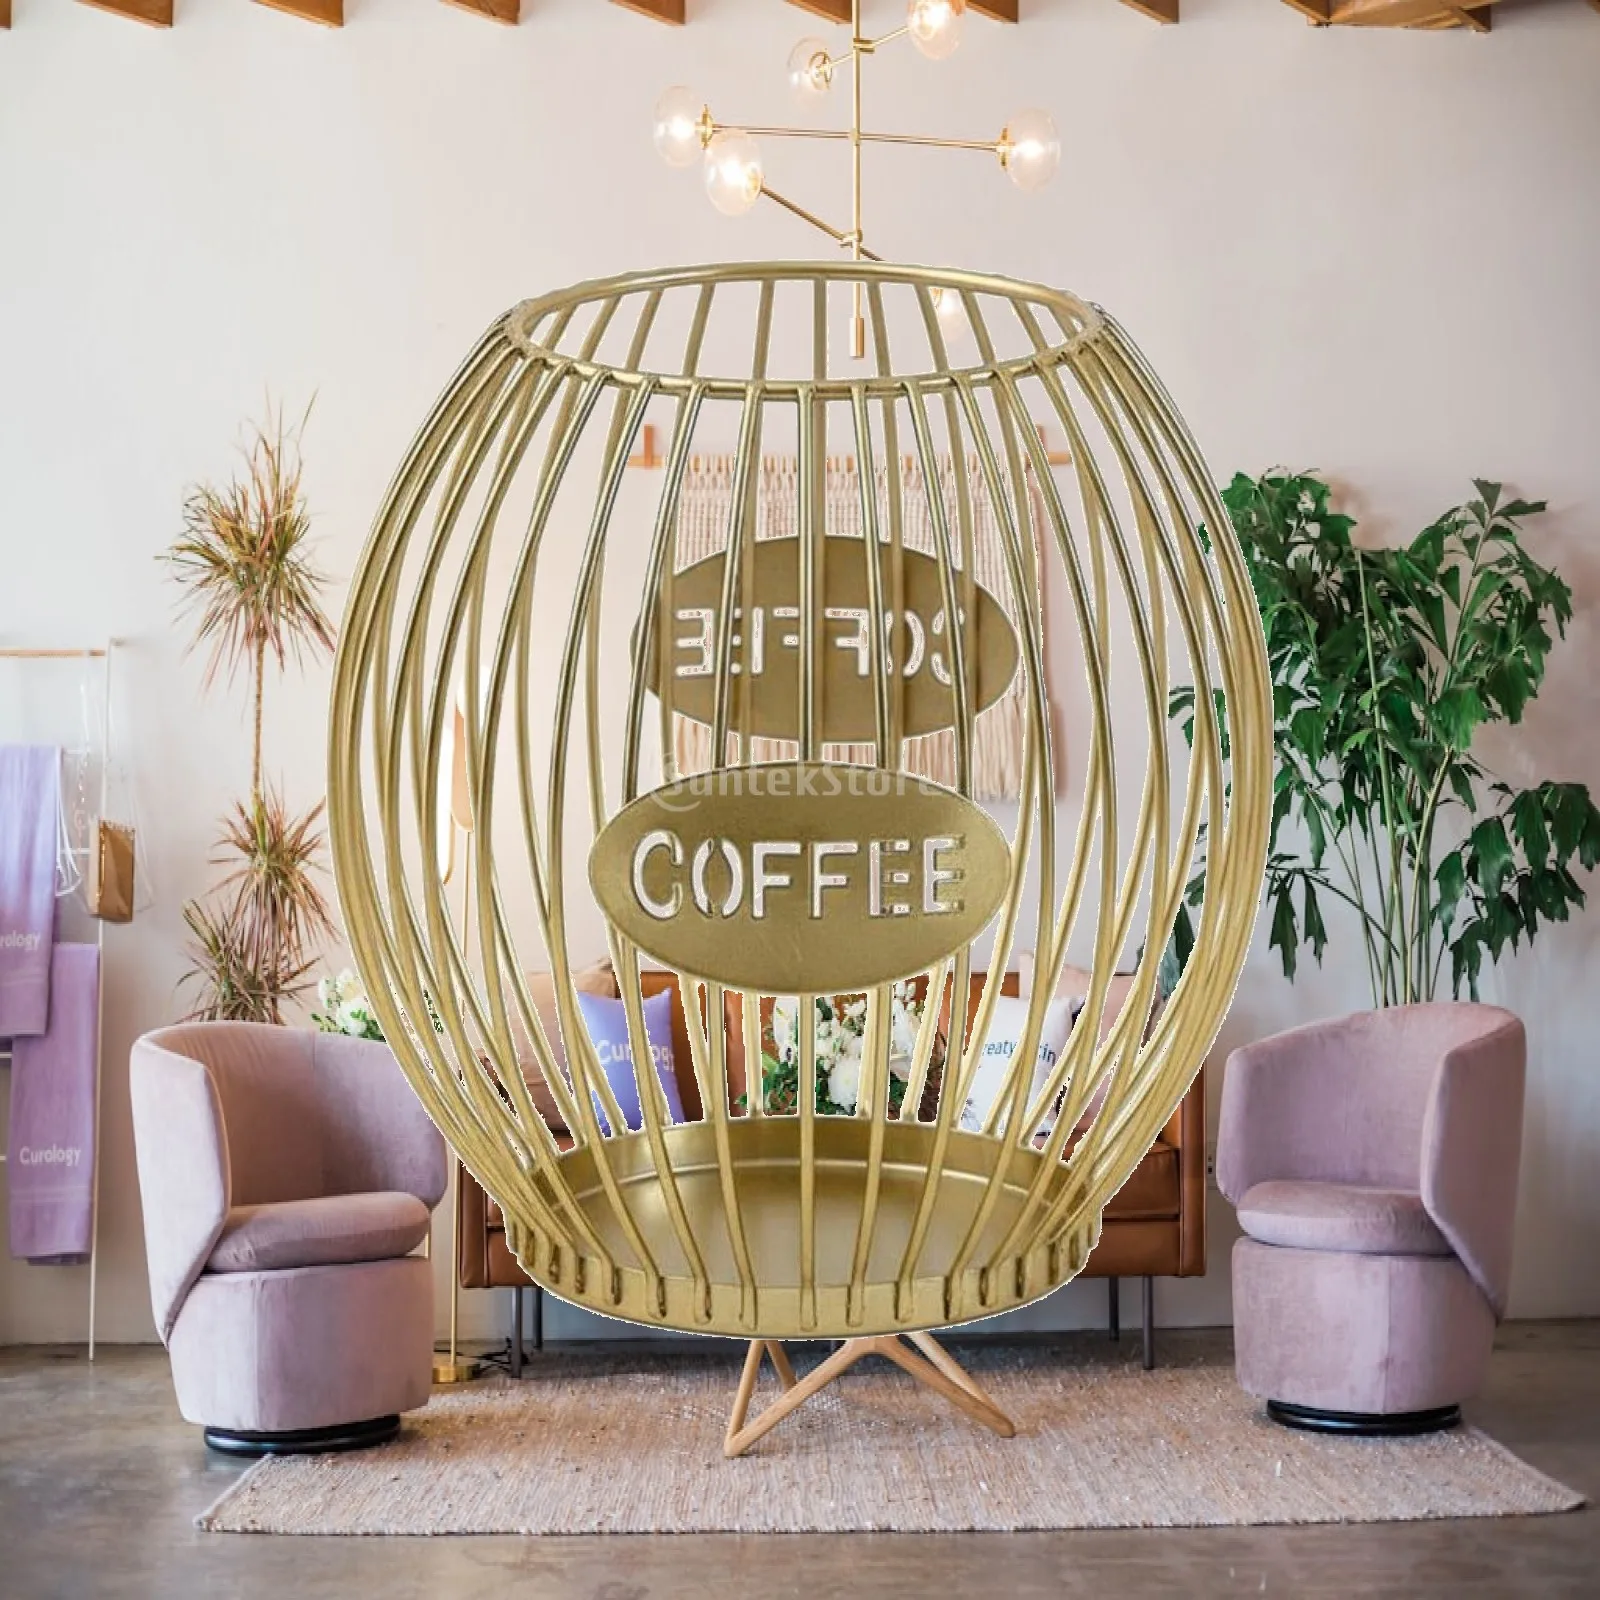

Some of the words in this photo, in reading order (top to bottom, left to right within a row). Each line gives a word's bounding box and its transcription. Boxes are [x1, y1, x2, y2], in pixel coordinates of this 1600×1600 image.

[632, 829, 965, 920] COFFEE
[0, 929, 41, 951] rology
[19, 1143, 81, 1167] Curology
